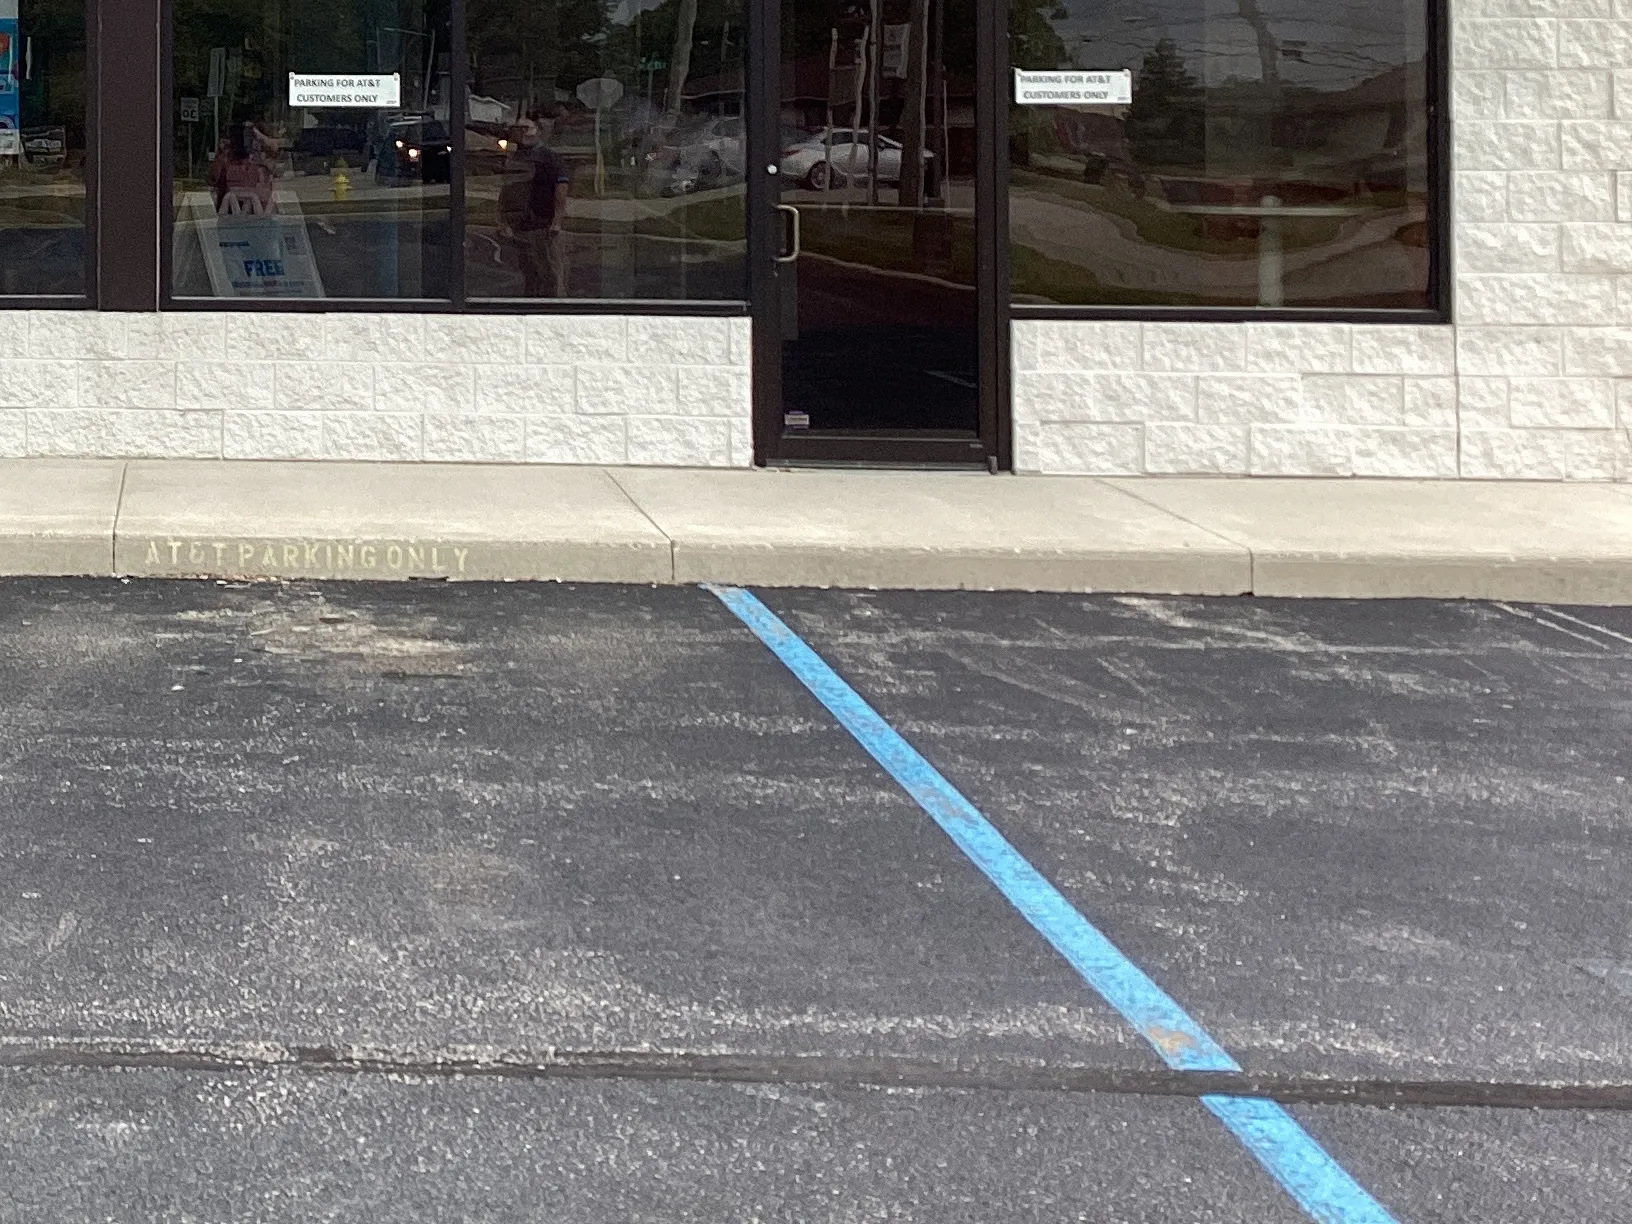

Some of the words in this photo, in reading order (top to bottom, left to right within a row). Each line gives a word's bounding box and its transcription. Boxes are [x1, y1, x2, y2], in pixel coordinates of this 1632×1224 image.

[294, 79, 334, 87] PARKING
[336, 79, 354, 87] FOR
[356, 79, 380, 87] AT&T
[1020, 75, 1062, 83] PARKING
[1064, 75, 1083, 83] FOR
[1085, 75, 1110, 83] AT&T
[296, 94, 352, 102] CUSTOMERS
[354, 94, 378, 103] ONLY
[1023, 91, 1081, 99] CUSTOMERS
[1083, 91, 1108, 99] ONLY
[243, 259, 285, 277] FREE
